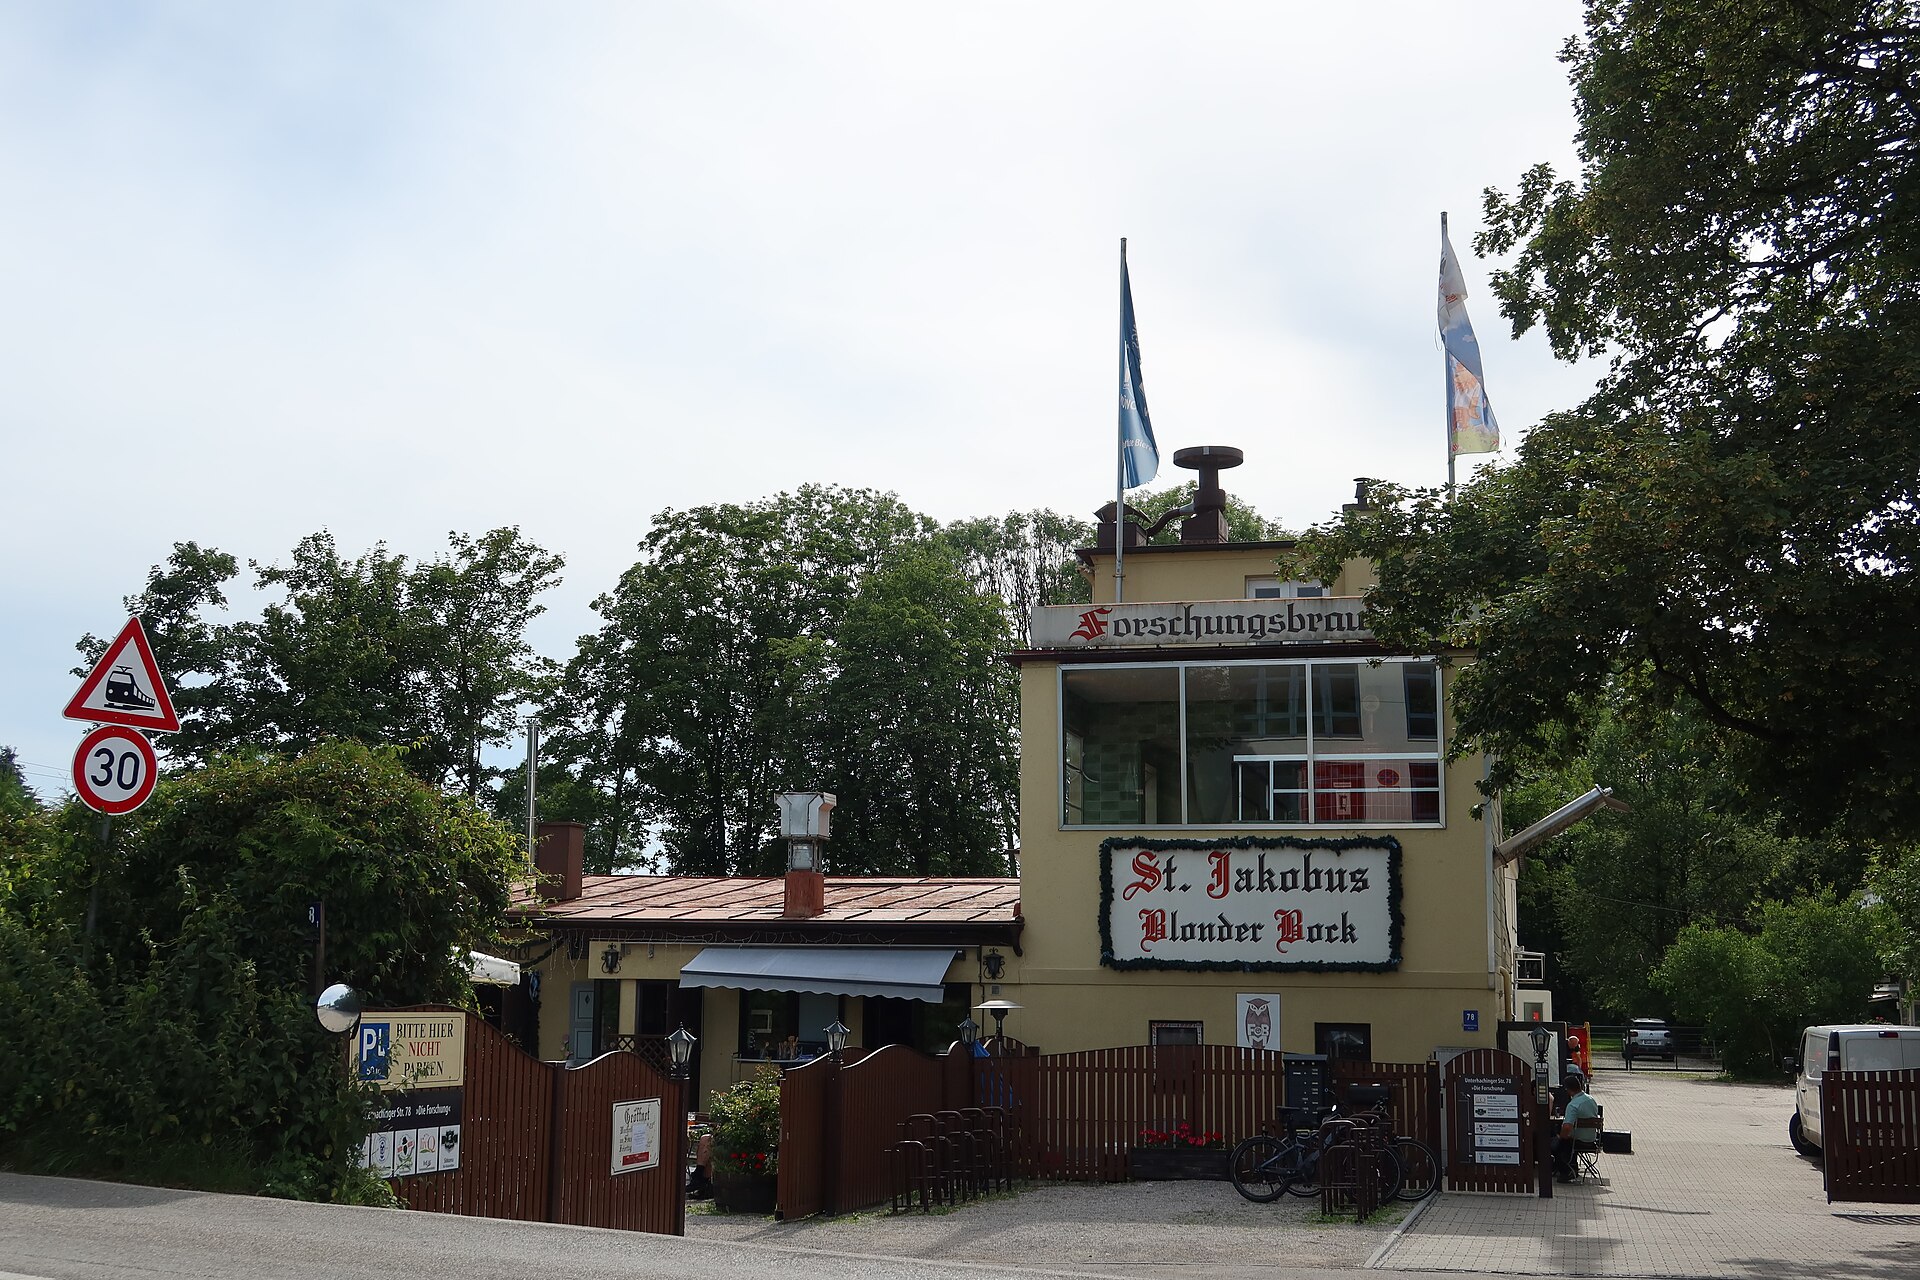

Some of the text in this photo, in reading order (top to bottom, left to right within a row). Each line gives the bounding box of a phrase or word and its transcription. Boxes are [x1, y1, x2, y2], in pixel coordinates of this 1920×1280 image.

[1069, 602, 1365, 641] Forschungsbrau
[90, 747, 140, 790] 30
[1122, 851, 1370, 900] St. Jakobus
[1138, 908, 1359, 953] Blonder Bock
[1466, 1013, 1475, 1021] 78
[396, 1022, 454, 1039] BITTE HIER
[408, 1041, 441, 1056] NICHT
[403, 1061, 444, 1077] PARKEN
[405, 1106, 411, 1117] 78
